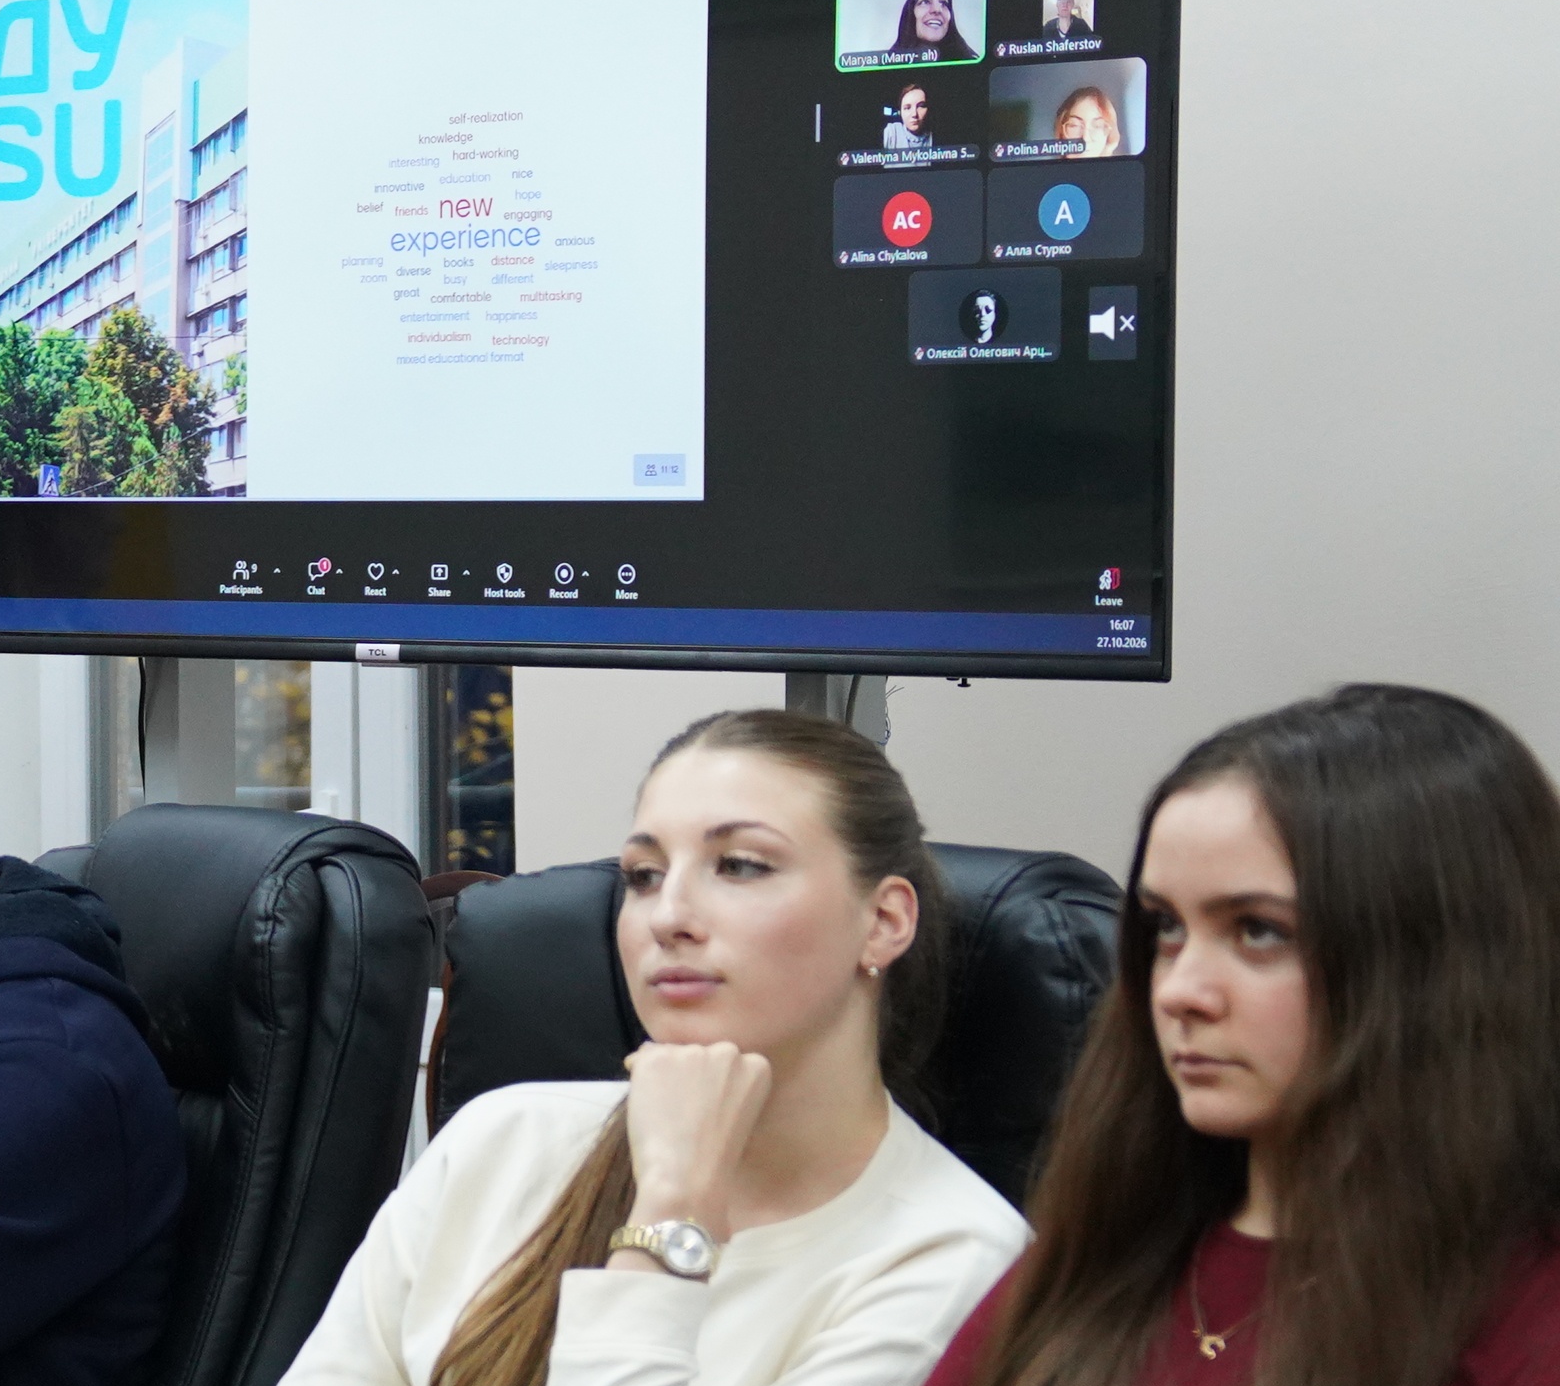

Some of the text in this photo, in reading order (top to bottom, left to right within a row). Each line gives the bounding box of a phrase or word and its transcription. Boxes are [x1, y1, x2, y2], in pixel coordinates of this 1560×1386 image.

[1009, 37, 1102, 55] Ruslan Shaferstov
[921, 49, 939, 63] ah)
[448, 110, 524, 125] self-realization
[418, 131, 474, 145] knowledge
[452, 147, 520, 162] hard-working
[1006, 141, 1084, 157] Polina Antipina
[388, 156, 440, 169] interesting
[851, 148, 958, 165] Valentyna Mykolaivna
[439, 172, 491, 185] education
[511, 168, 534, 180] nice
[374, 181, 425, 194] innovative
[514, 189, 542, 202] hope
[356, 201, 385, 214] belief
[394, 205, 429, 218] friends
[439, 197, 494, 219] new
[503, 208, 553, 223] engaging
[892, 211, 922, 230] AC
[390, 223, 541, 257] experience
[554, 235, 595, 247] anxious
[850, 249, 928, 264] Alina Chykalova
[1005, 243, 1072, 258] Алла Стурко
[341, 255, 384, 269] planning
[443, 257, 475, 268] books
[490, 254, 536, 266] distance
[544, 259, 599, 273] sleepiness
[360, 273, 388, 284] zoom
[395, 266, 432, 278] diverse
[443, 273, 468, 286] busy
[491, 273, 535, 285] different
[393, 287, 421, 301] great
[430, 291, 492, 304] comfortable
[519, 290, 583, 304] multitasking
[399, 311, 471, 323] entertainment
[485, 309, 539, 323] happiness
[407, 331, 472, 344] individualism
[491, 334, 550, 348] technology
[396, 350, 525, 365] mixed educational format
[926, 346, 968, 360] Олексій
[969, 345, 1021, 360] Олегович
[250, 563, 258, 574] 9
[219, 583, 264, 597] Participants
[306, 585, 326, 597] Chat
[364, 585, 387, 597] React
[427, 586, 452, 598] Share
[484, 587, 526, 599] Host tools
[549, 588, 579, 600] Record
[615, 589, 639, 601] More
[1094, 594, 1124, 607] Leave
[1109, 619, 1136, 631] 16:07
[1096, 636, 1148, 649] 27.10.2026
[367, 647, 388, 657] TCL
